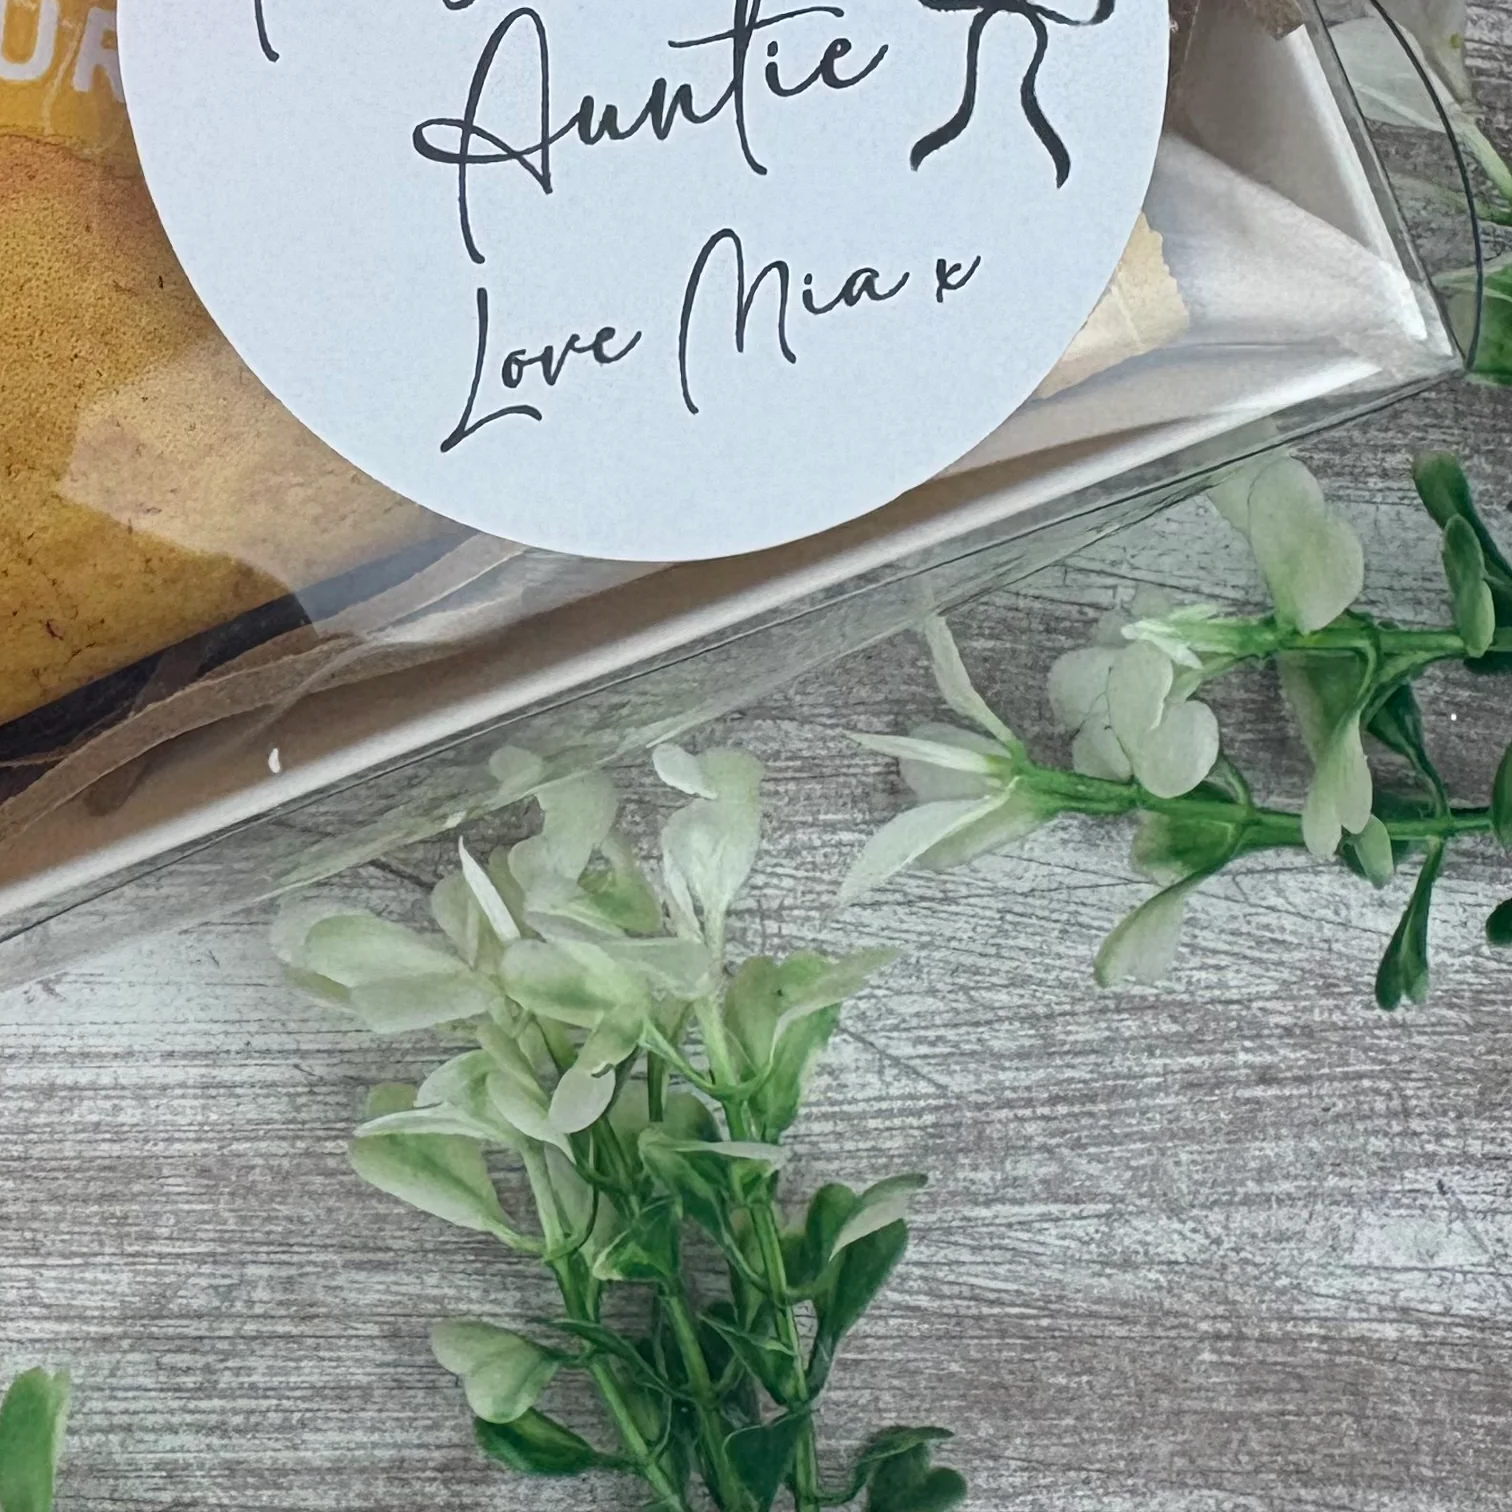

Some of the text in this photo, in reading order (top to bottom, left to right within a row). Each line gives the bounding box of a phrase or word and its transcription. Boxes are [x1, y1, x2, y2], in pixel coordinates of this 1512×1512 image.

[441, 229, 981, 452] Love Mia x
